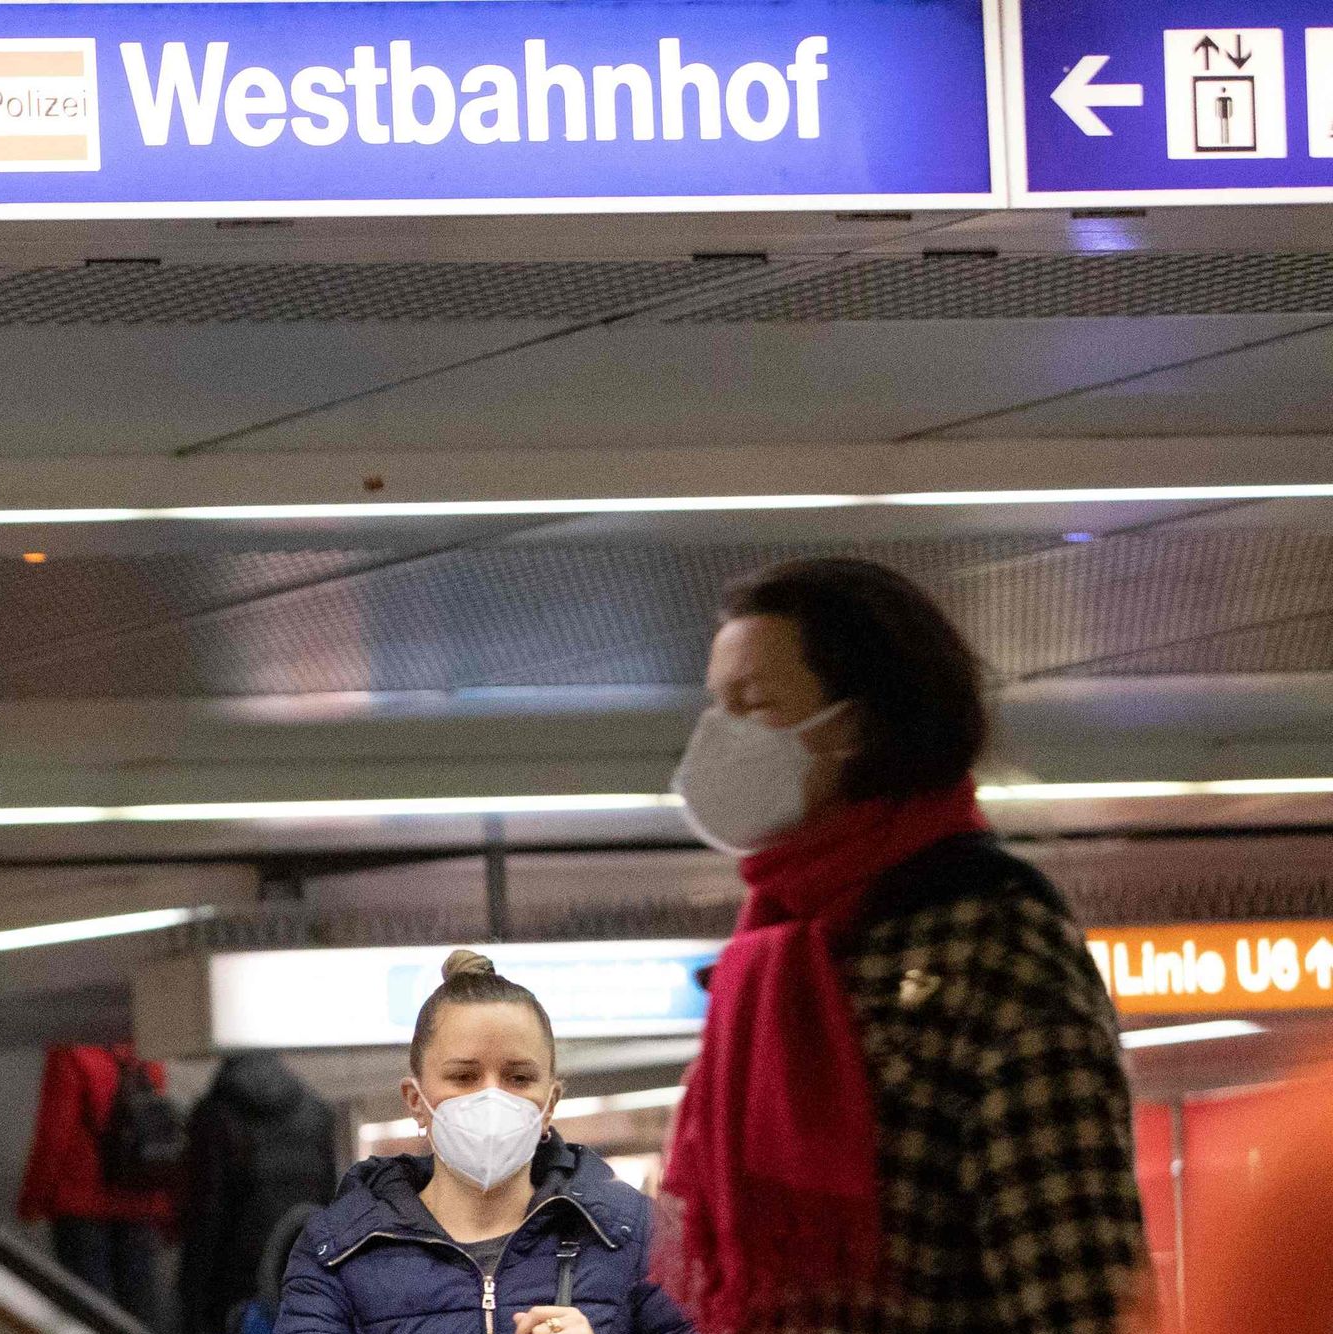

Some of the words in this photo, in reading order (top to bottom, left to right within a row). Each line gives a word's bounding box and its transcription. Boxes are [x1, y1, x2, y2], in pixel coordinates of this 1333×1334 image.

[119, 36, 828, 147] Westbahnhof
[1113, 939, 1227, 997] Linie
[1235, 937, 1301, 993] U6
